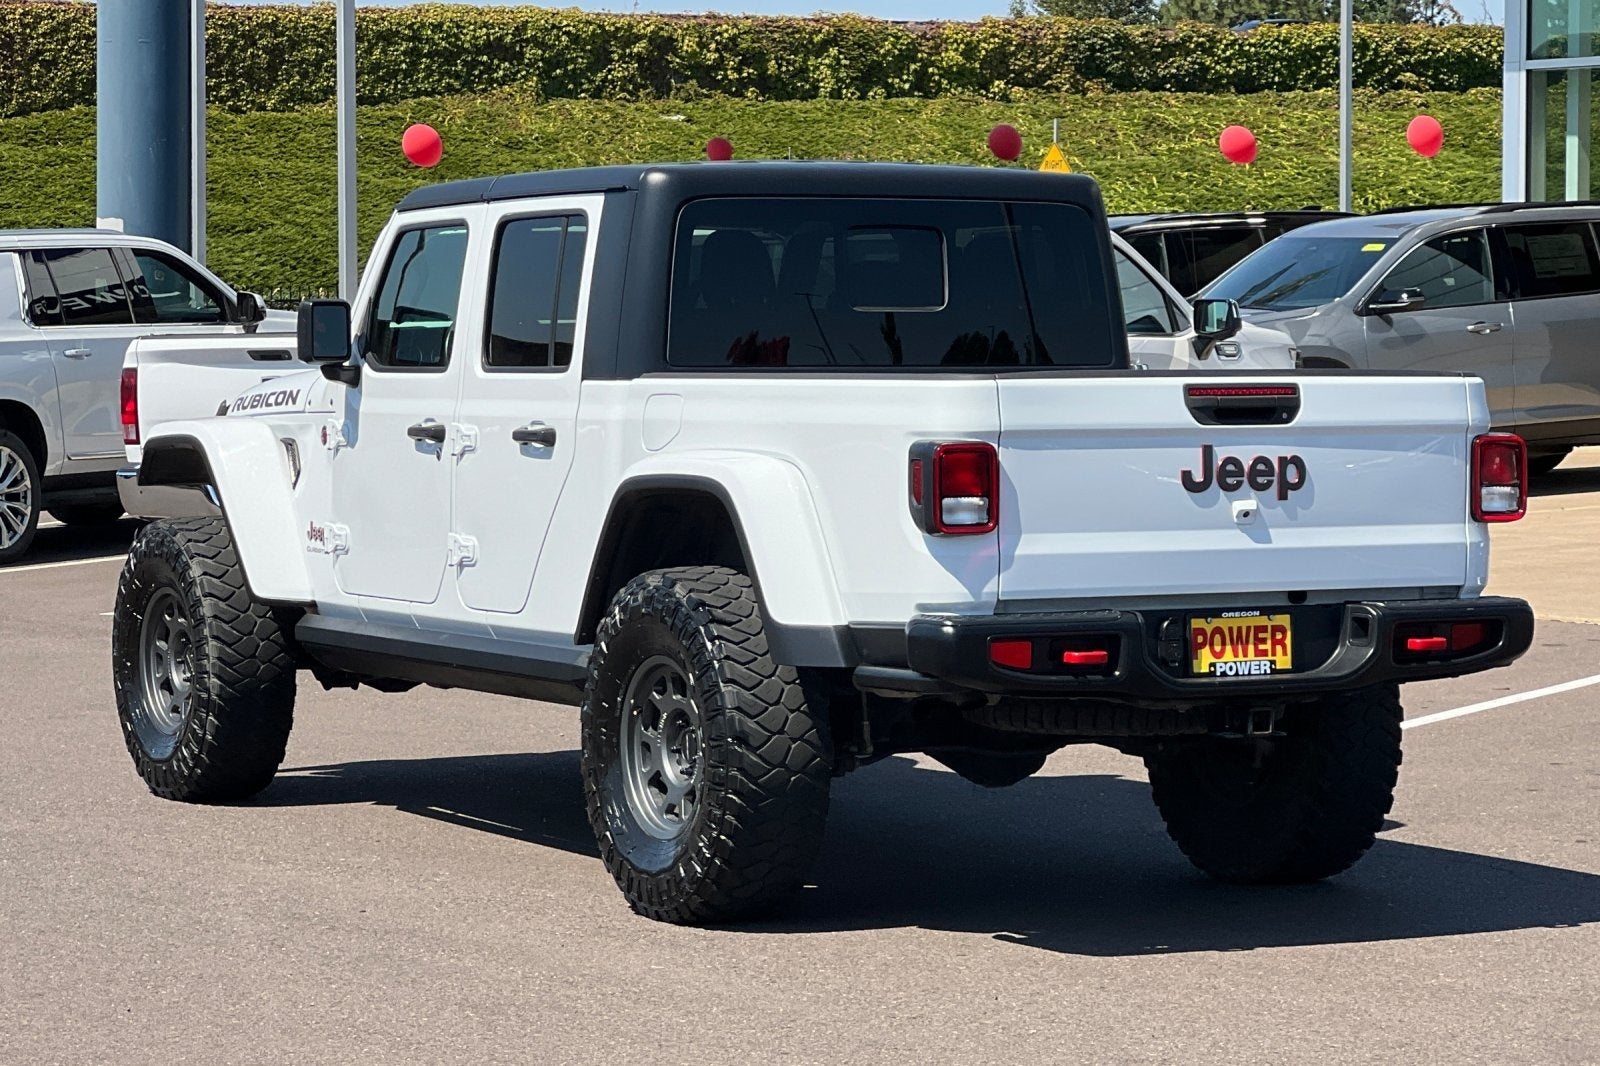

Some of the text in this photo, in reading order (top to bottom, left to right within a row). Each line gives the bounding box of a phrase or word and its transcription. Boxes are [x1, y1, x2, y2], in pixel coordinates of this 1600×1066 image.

[231, 389, 301, 413] RUBICON
[1180, 444, 1307, 501] Jeep
[1221, 610, 1260, 618] OREGON
[1191, 624, 1289, 661] POWER
[1215, 660, 1271, 676] POWER
